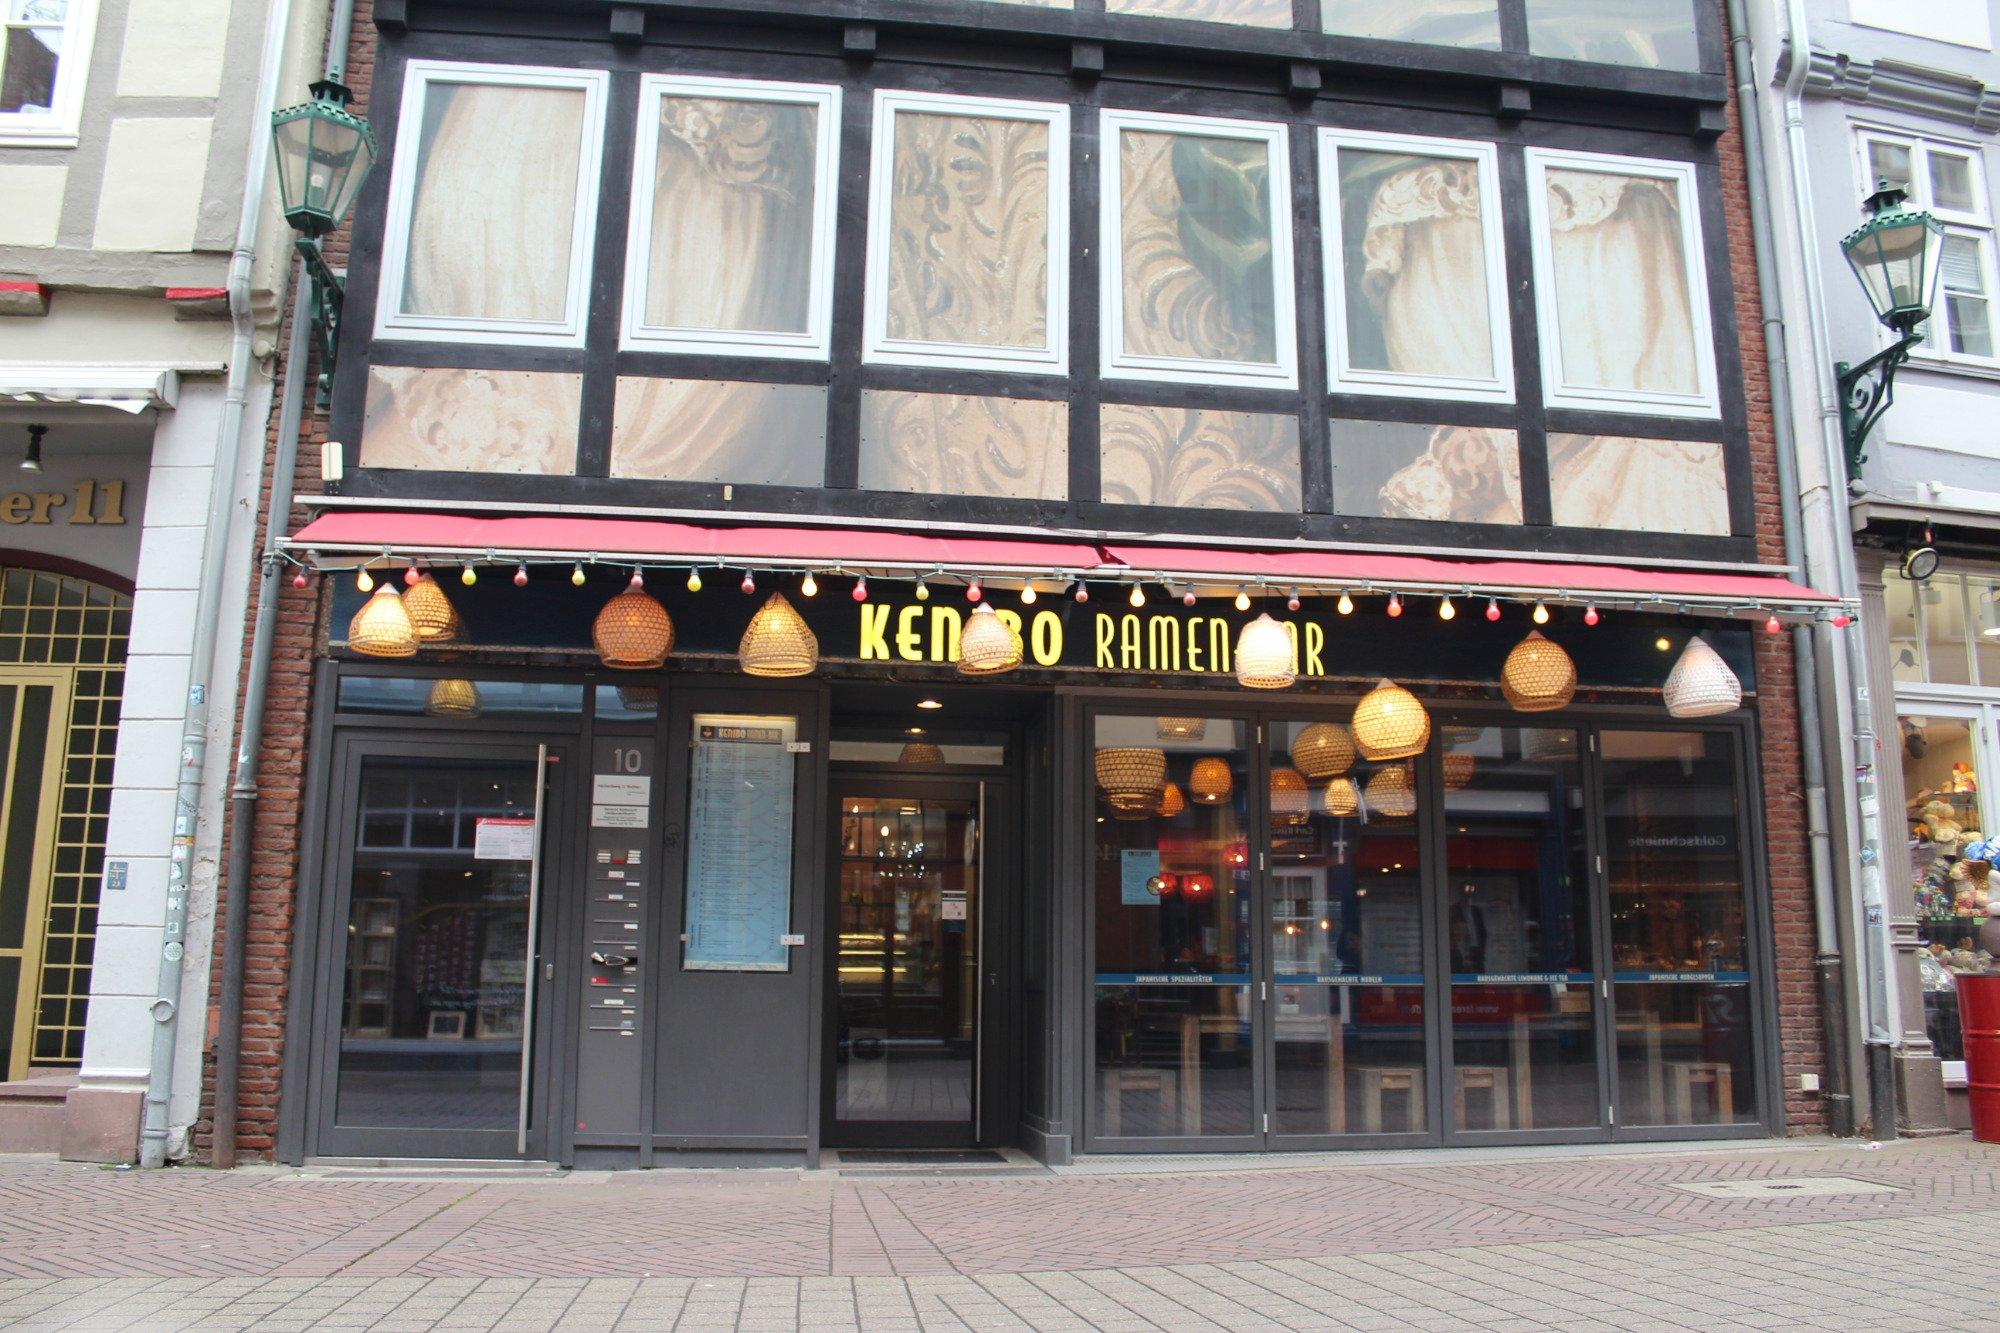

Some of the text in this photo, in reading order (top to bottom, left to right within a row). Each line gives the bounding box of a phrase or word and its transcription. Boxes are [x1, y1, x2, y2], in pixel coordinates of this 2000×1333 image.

[1095, 612, 1231, 673] RAMEN
[1234, 619, 1325, 676] AR
[614, 749, 642, 773] 10
[1135, 975, 1169, 983] JAPANISCHE
